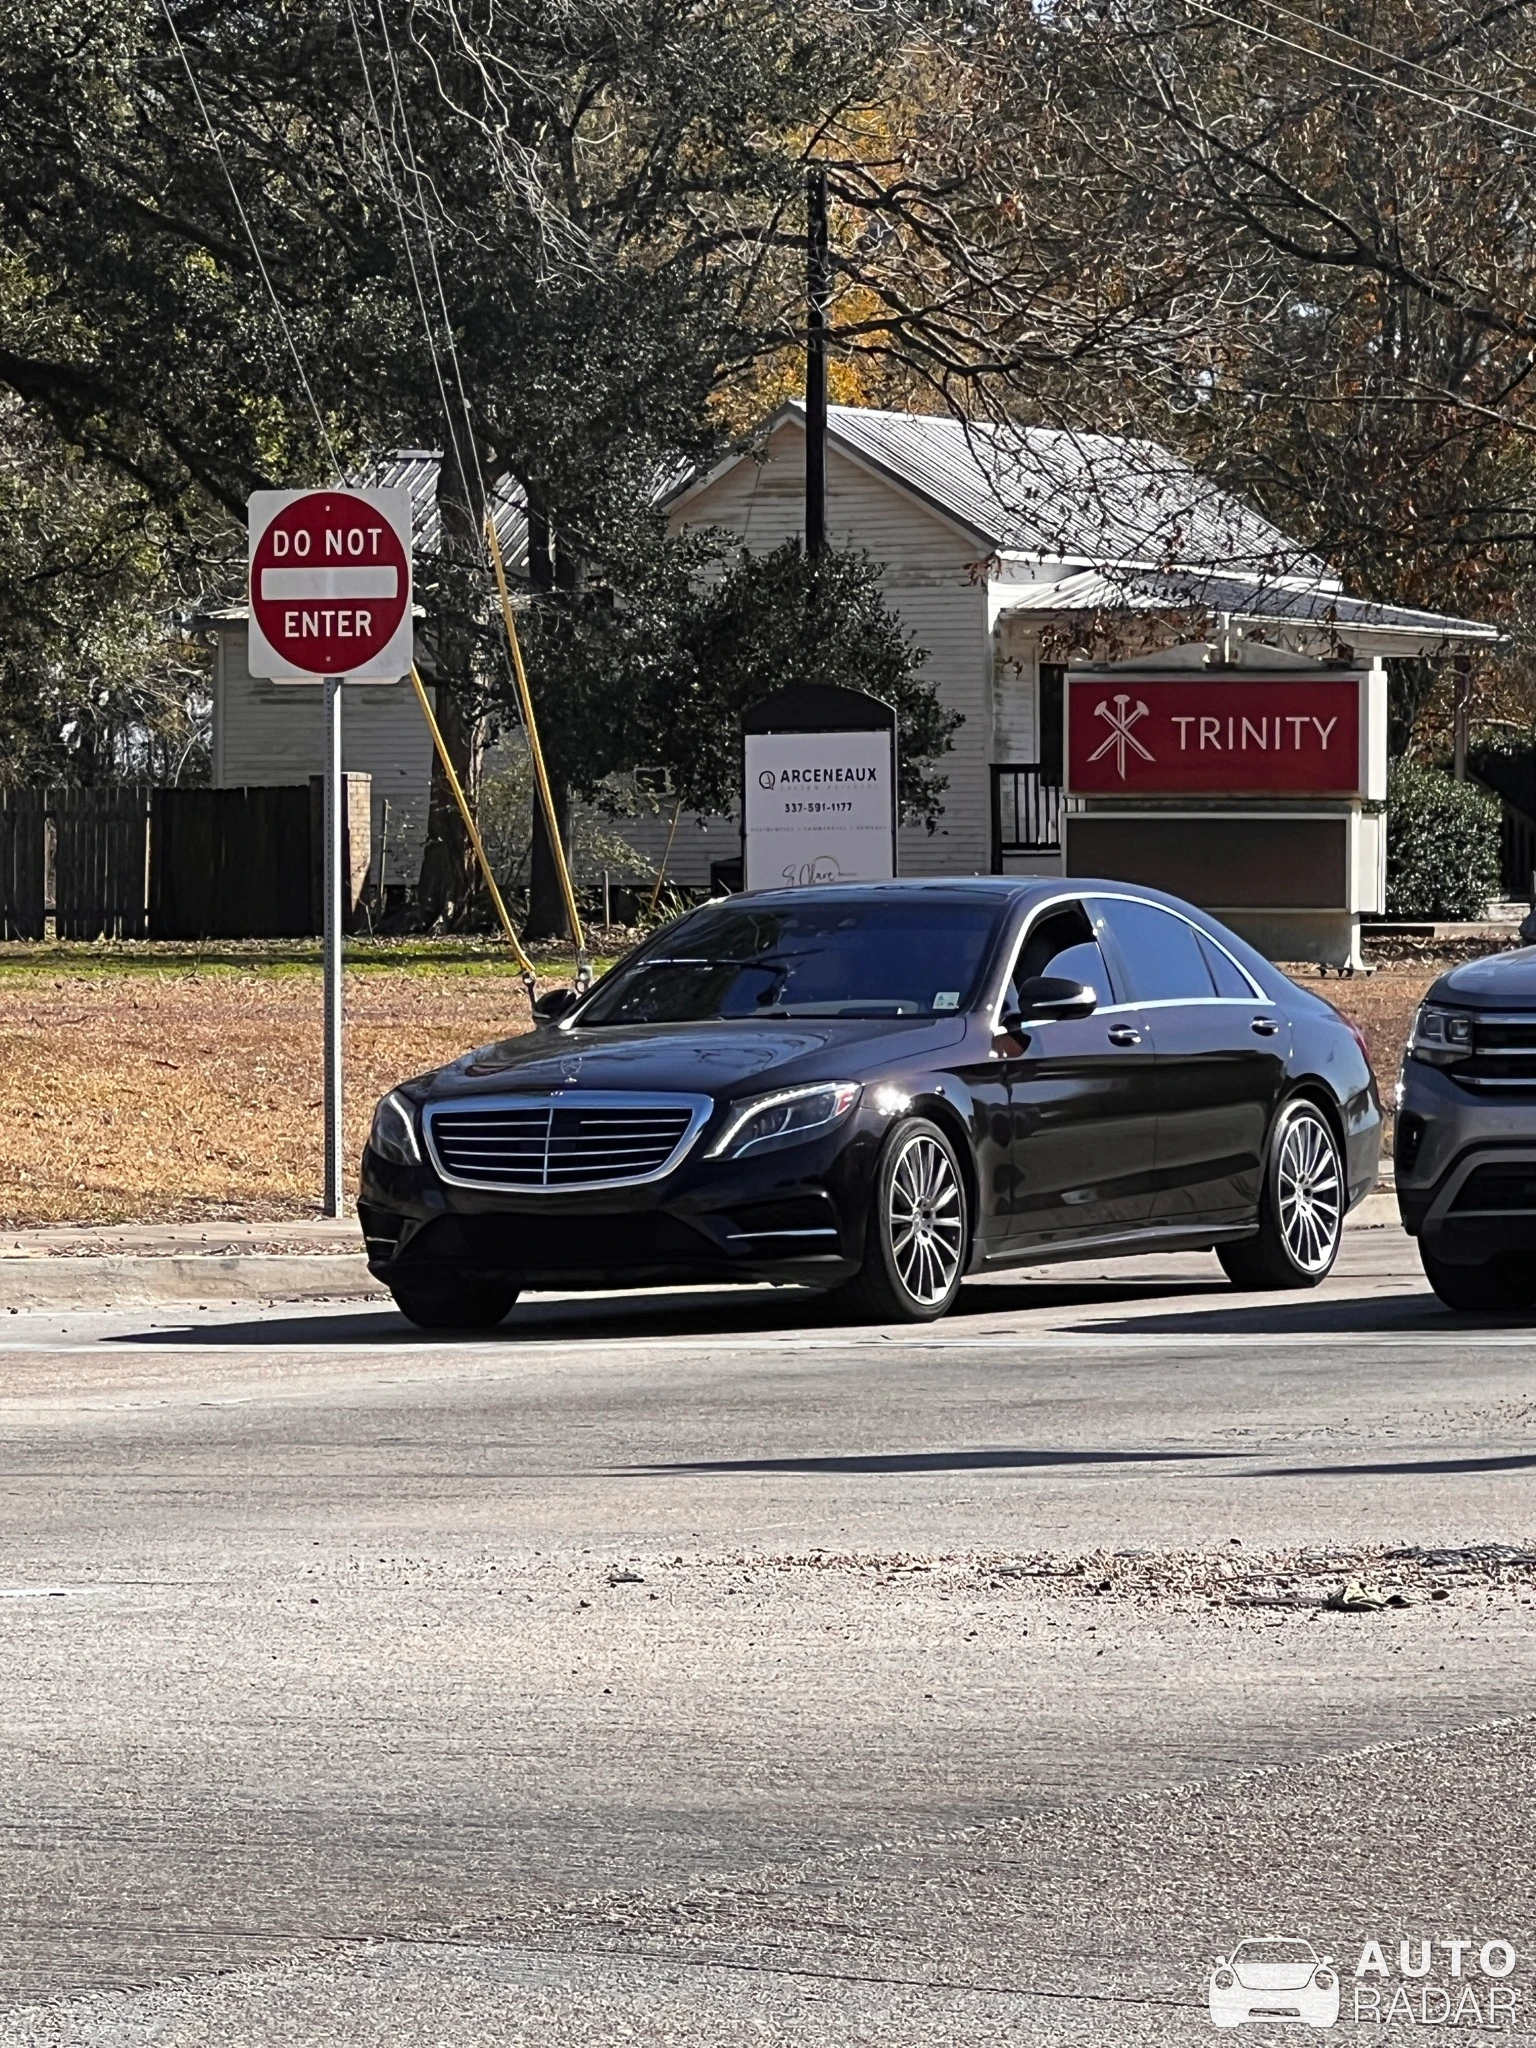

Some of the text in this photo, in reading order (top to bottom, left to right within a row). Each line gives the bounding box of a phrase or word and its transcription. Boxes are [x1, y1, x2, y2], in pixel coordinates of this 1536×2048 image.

[273, 528, 382, 557] DO NOT
[285, 610, 372, 638] ENTER
[1171, 716, 1338, 750] TRINITY
[780, 767, 877, 784] ARCENEAUX
[785, 802, 852, 813] 337-591-1177
